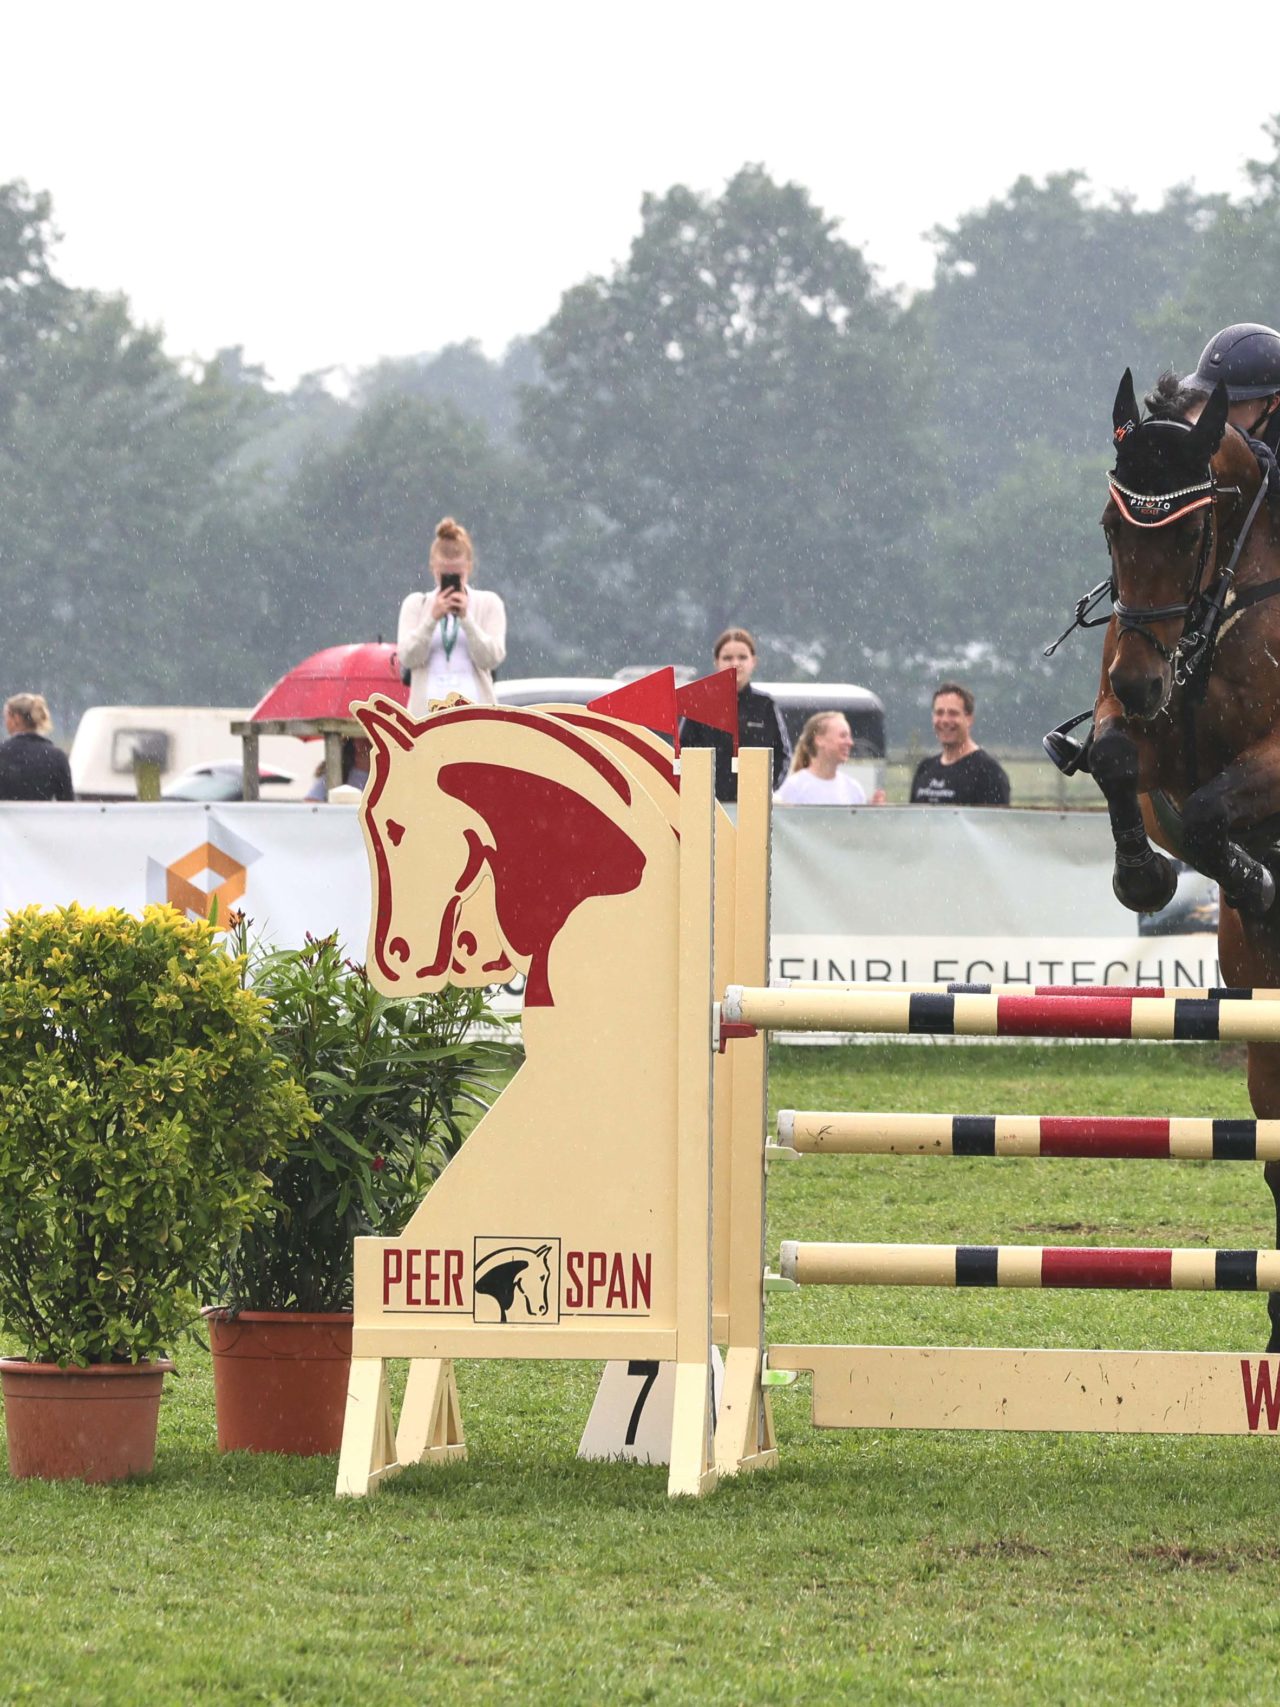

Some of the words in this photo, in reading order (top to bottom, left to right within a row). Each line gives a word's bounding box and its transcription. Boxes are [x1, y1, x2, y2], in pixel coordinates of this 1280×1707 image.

[383, 1248, 464, 1307] PEER
[566, 1251, 652, 1309] SPAN
[624, 1360, 661, 1446] 7
